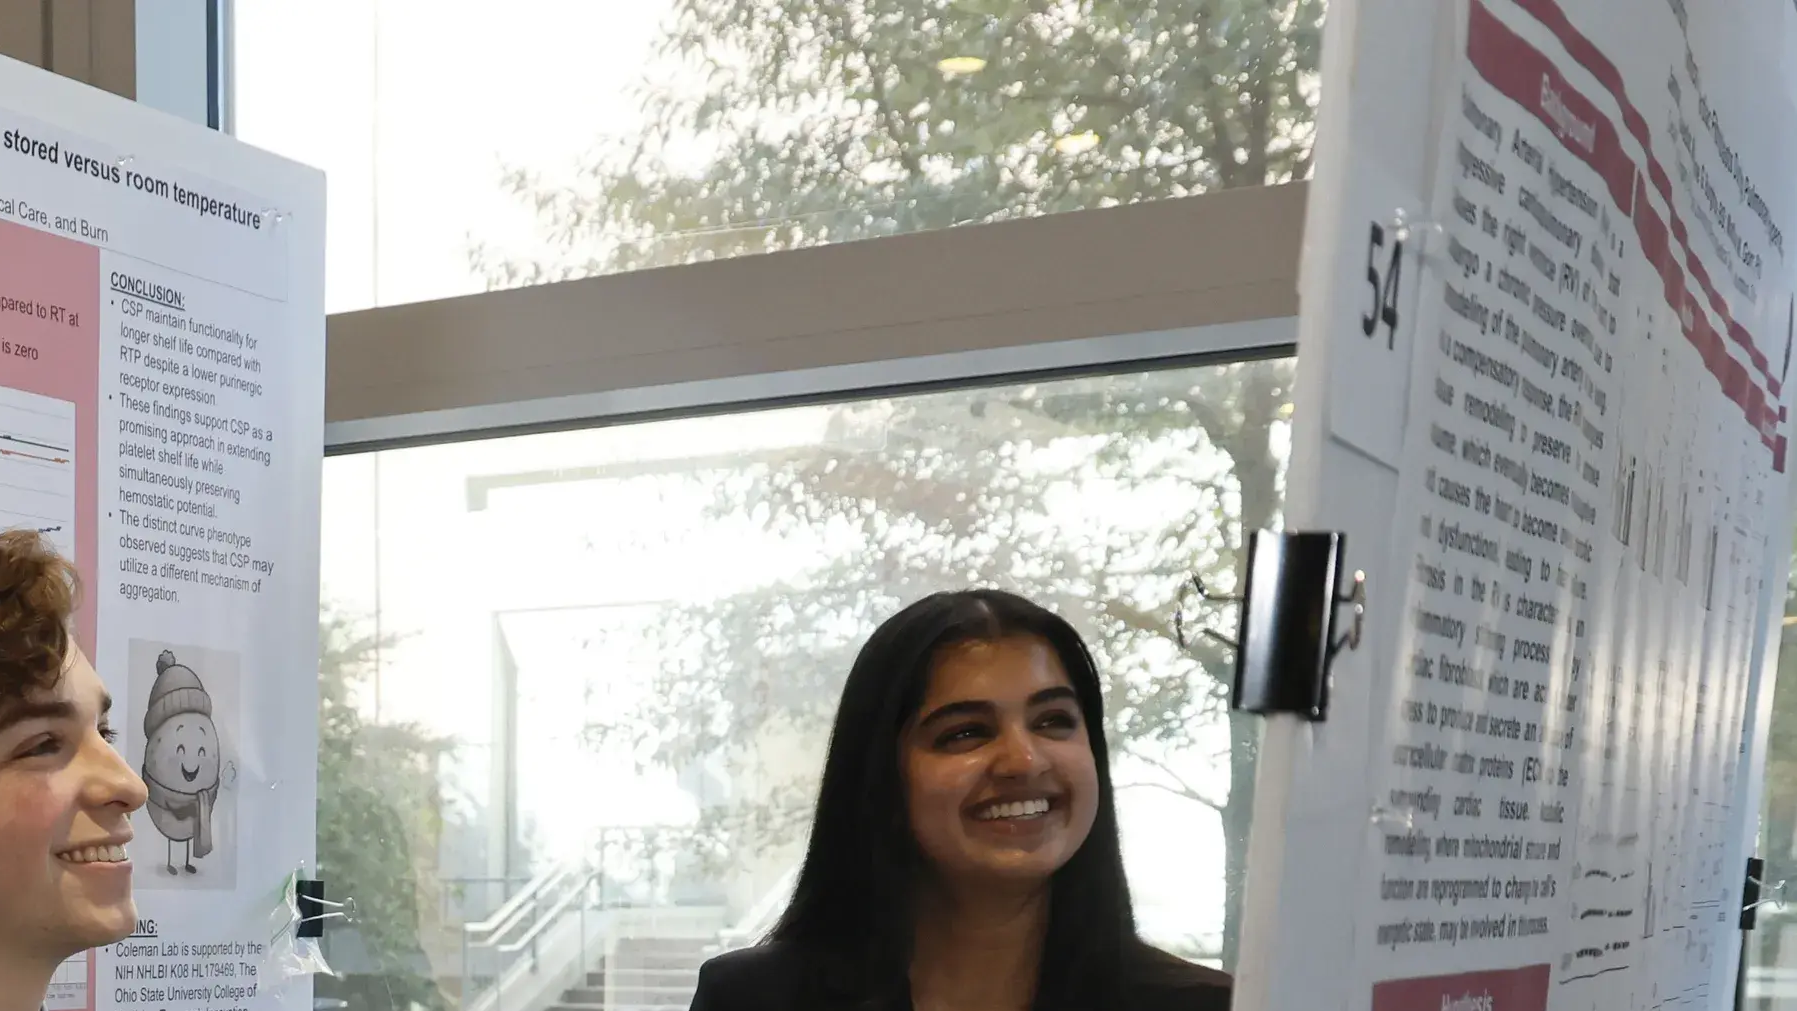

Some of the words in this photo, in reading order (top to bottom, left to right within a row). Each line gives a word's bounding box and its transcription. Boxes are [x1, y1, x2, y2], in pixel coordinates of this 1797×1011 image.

[3, 130, 59, 165] stored
[64, 150, 121, 184] versus
[126, 171, 169, 199] room
[173, 183, 261, 230] temperature
[18, 201, 51, 229] Care,
[55, 216, 77, 234] and
[80, 219, 109, 242] Burn
[111, 271, 186, 309] CONCLUSION:
[1363, 220, 1403, 351] 54
[121, 298, 143, 318] CSP
[145, 309, 186, 331] maintain
[188, 317, 244, 349] functionality
[245, 333, 258, 350] for
[119, 582, 180, 603] aggregation.
[115, 965, 134, 980] NIH
[136, 964, 168, 979] NHLBI
[170, 963, 189, 979] K08
[191, 963, 237, 978] HL179469,
[239, 962, 257, 977] The
